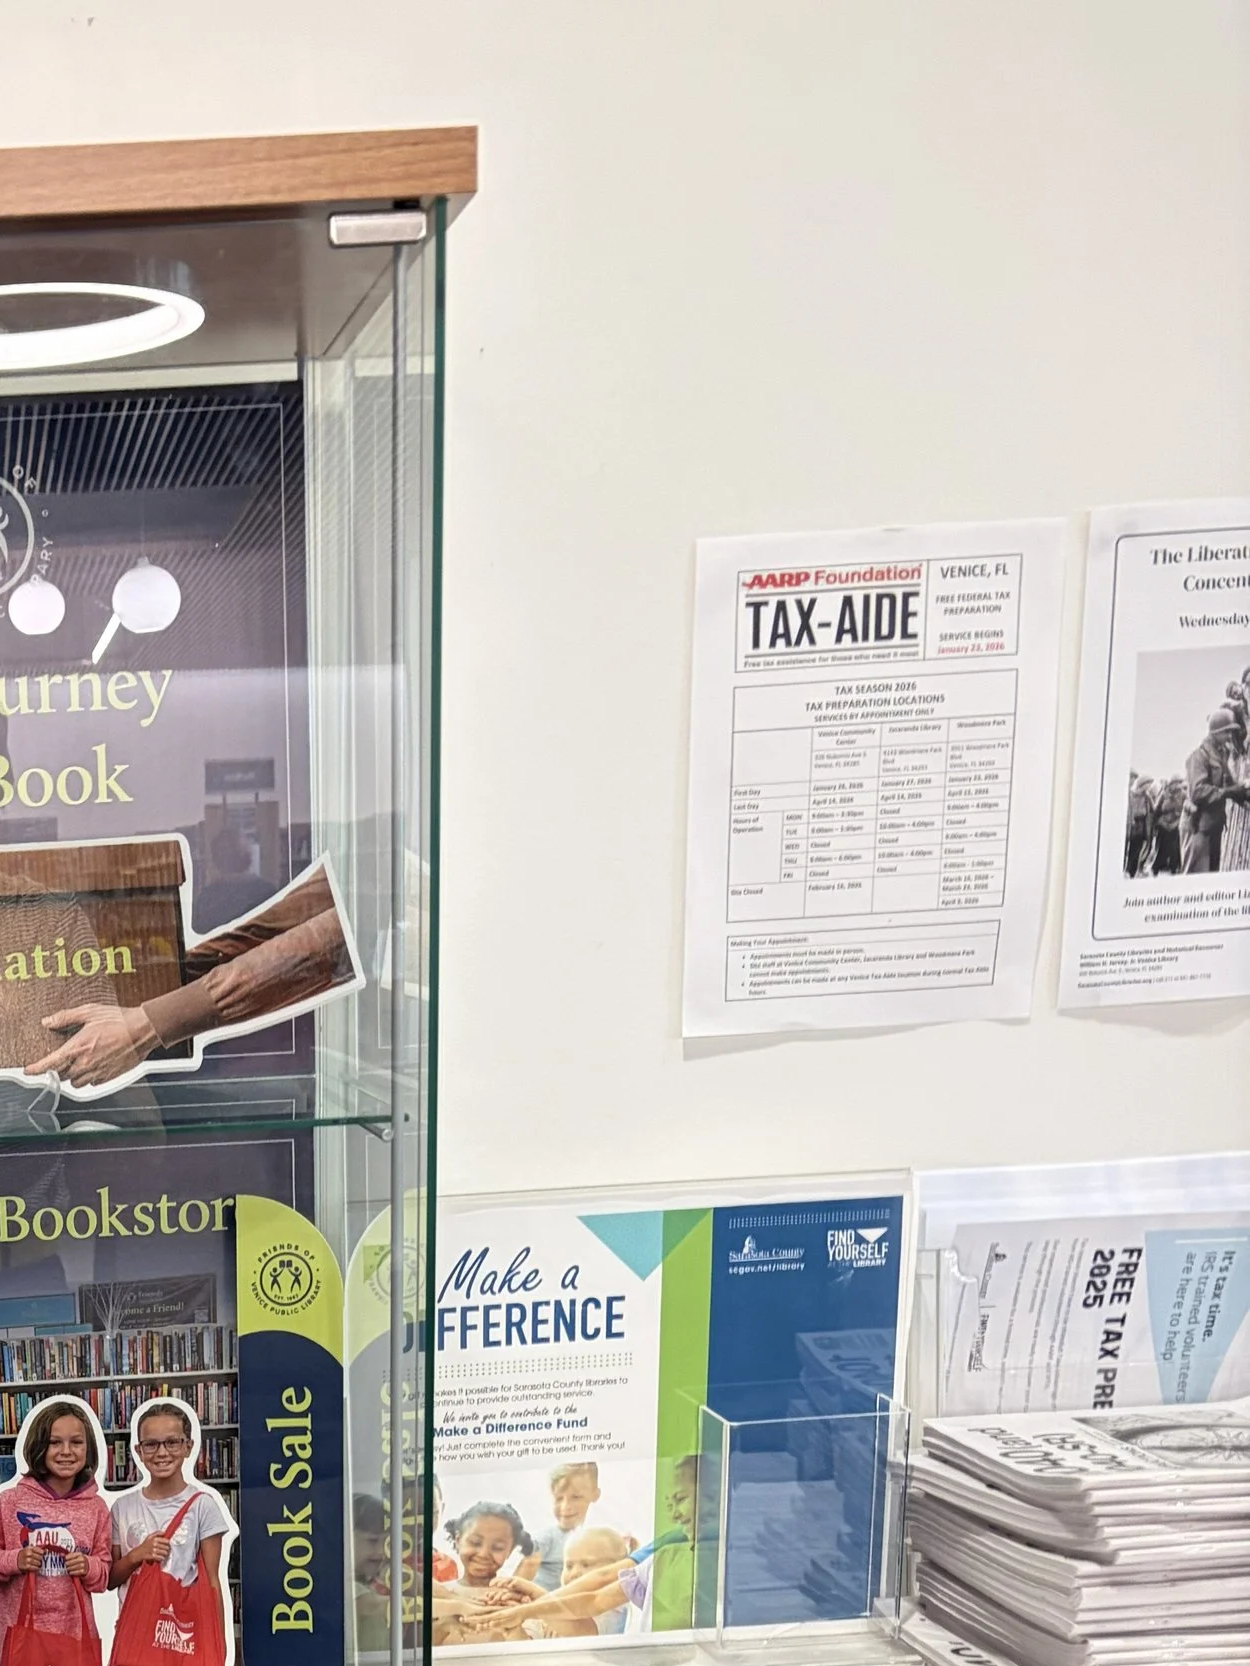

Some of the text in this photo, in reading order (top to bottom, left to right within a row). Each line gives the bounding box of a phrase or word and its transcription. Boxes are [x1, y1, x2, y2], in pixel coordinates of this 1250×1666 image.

[12, 464, 37, 490] OF
[1150, 544, 1250, 565] The Liberat
[743, 565, 921, 590] AARP Foundation
[940, 563, 1009, 579] VENICE, FL
[935, 591, 1011, 605] FREE FEDERAL TAX
[943, 604, 1002, 616] PREPARATION
[745, 591, 920, 650] TAX-AIDE
[939, 629, 1004, 642] SERVICE BEGINS
[937, 644, 968, 655] January
[835, 685, 853, 695] TAX
[855, 683, 893, 694] SEASON
[805, 694, 945, 713] TAX PREPARATION LOCATIONS
[814, 713, 848, 723] SERVICES
[860, 709, 913, 720] APPOINTMENT
[915, 708, 934, 717] ONLY
[827, 1229, 854, 1246] FIND
[257, 1243, 299, 1263] FRIENDS
[772, 1247, 805, 1259] County
[827, 1242, 889, 1261] YOURSELF
[853, 1259, 886, 1267] LIBRARY
[1183, 1252, 1196, 1273] are
[437, 1246, 580, 1304] Make a
[1082, 1249, 1115, 1308] 2025
[251, 1280, 321, 1315] VENICE PUBLIC LIBRARY
[1174, 1279, 1192, 1309] here
[1202, 1251, 1235, 1342] It's tax time.
[1093, 1247, 1143, 1409] FREE TAX PRE
[1170, 1312, 1182, 1326] to
[1175, 1251, 1216, 1402] IRS trained volunteers
[465, 1377, 628, 1396] possible for Sarasota County libraries to
[476, 1394, 509, 1406] provide
[511, 1391, 561, 1403] outstanding
[432, 1417, 588, 1438] Make a Difference Fund
[446, 1432, 612, 1452] Just complete the convenient form and
[439, 1453, 457, 1462] how
[459, 1452, 475, 1461] you
[477, 1449, 494, 1459] wish
[496, 1449, 515, 1459] your
[516, 1447, 530, 1458] gift
[532, 1447, 540, 1455] to
[542, 1446, 553, 1454] be
[580, 1442, 604, 1452] Thank
[265, 1384, 314, 1635] Book Sale
[36, 1531, 58, 1544] AAU
[155, 1620, 176, 1634] FIND
